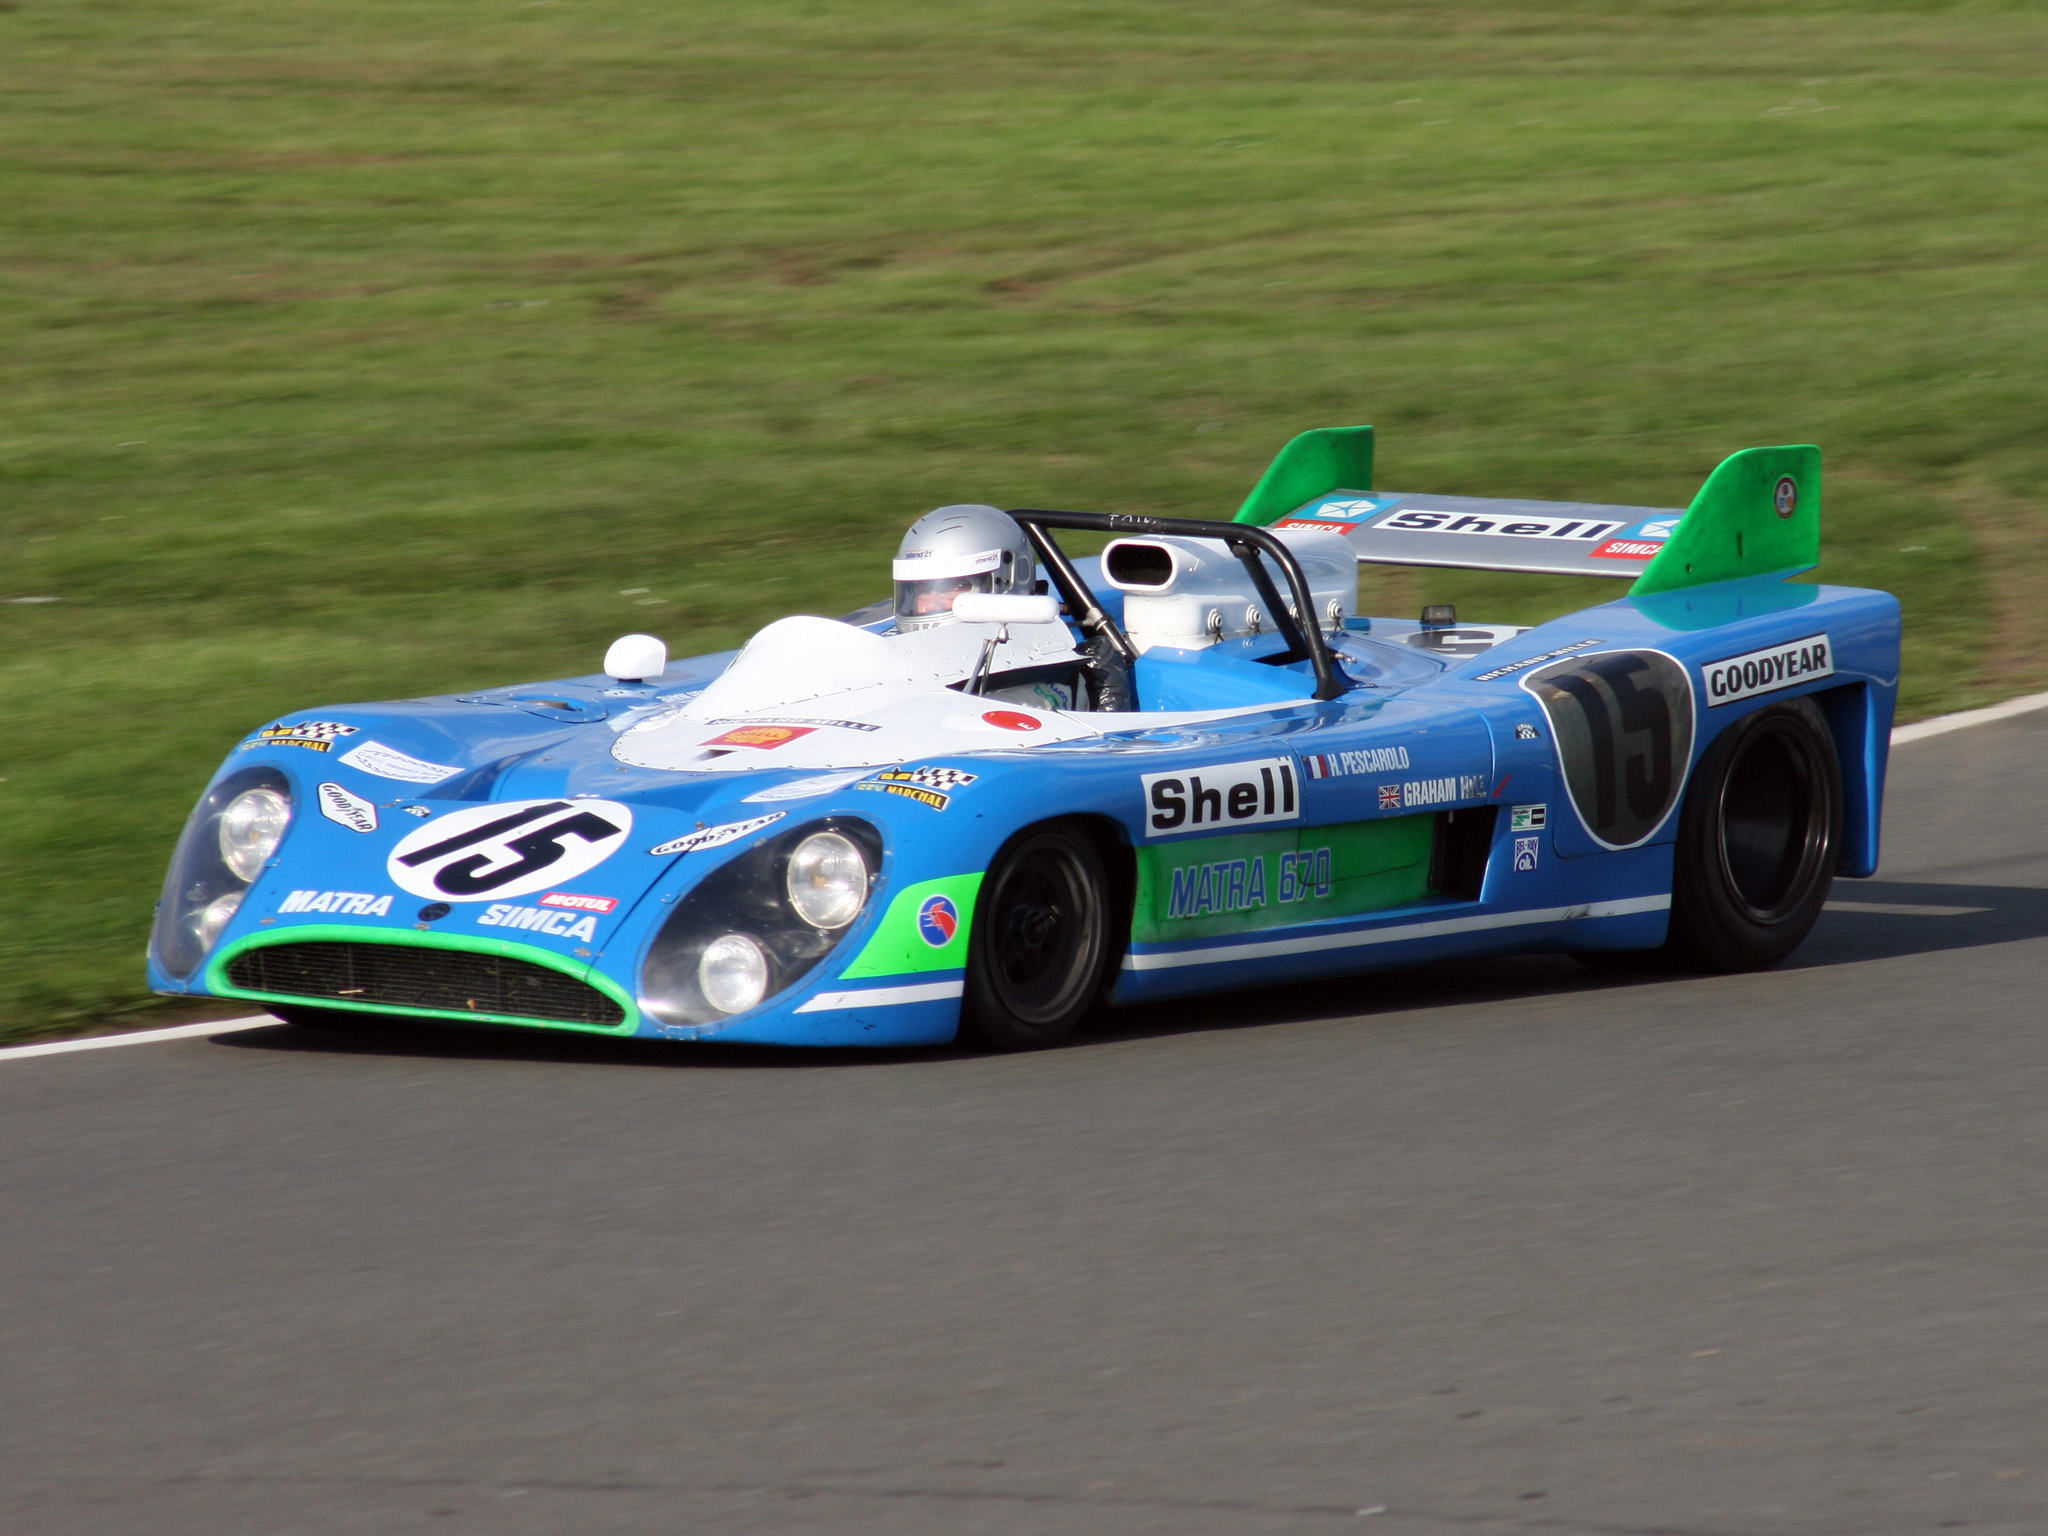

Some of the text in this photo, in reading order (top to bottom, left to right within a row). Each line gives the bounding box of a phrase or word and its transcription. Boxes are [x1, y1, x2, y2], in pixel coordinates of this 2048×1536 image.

[1387, 512, 1612, 538] Shell
[1476, 638, 1601, 682] RICHARD MILLE
[1710, 643, 1827, 697] GOODYEAR
[812, 719, 878, 731] MILLE
[1544, 653, 1672, 829] 15
[1326, 745, 1410, 777] H. PESCAROLO
[322, 784, 373, 831] GOODYEAR
[885, 785, 943, 808] MARCHAL
[1151, 764, 1295, 830] Shell
[1403, 778, 1457, 807] GRAHAM
[394, 800, 623, 896] 15
[655, 812, 786, 854] GOODYEAR
[542, 893, 613, 911] MOTUL
[1166, 847, 1331, 918] MATRA 670
[276, 890, 394, 917] MATRA
[476, 904, 599, 943] SIMCA
